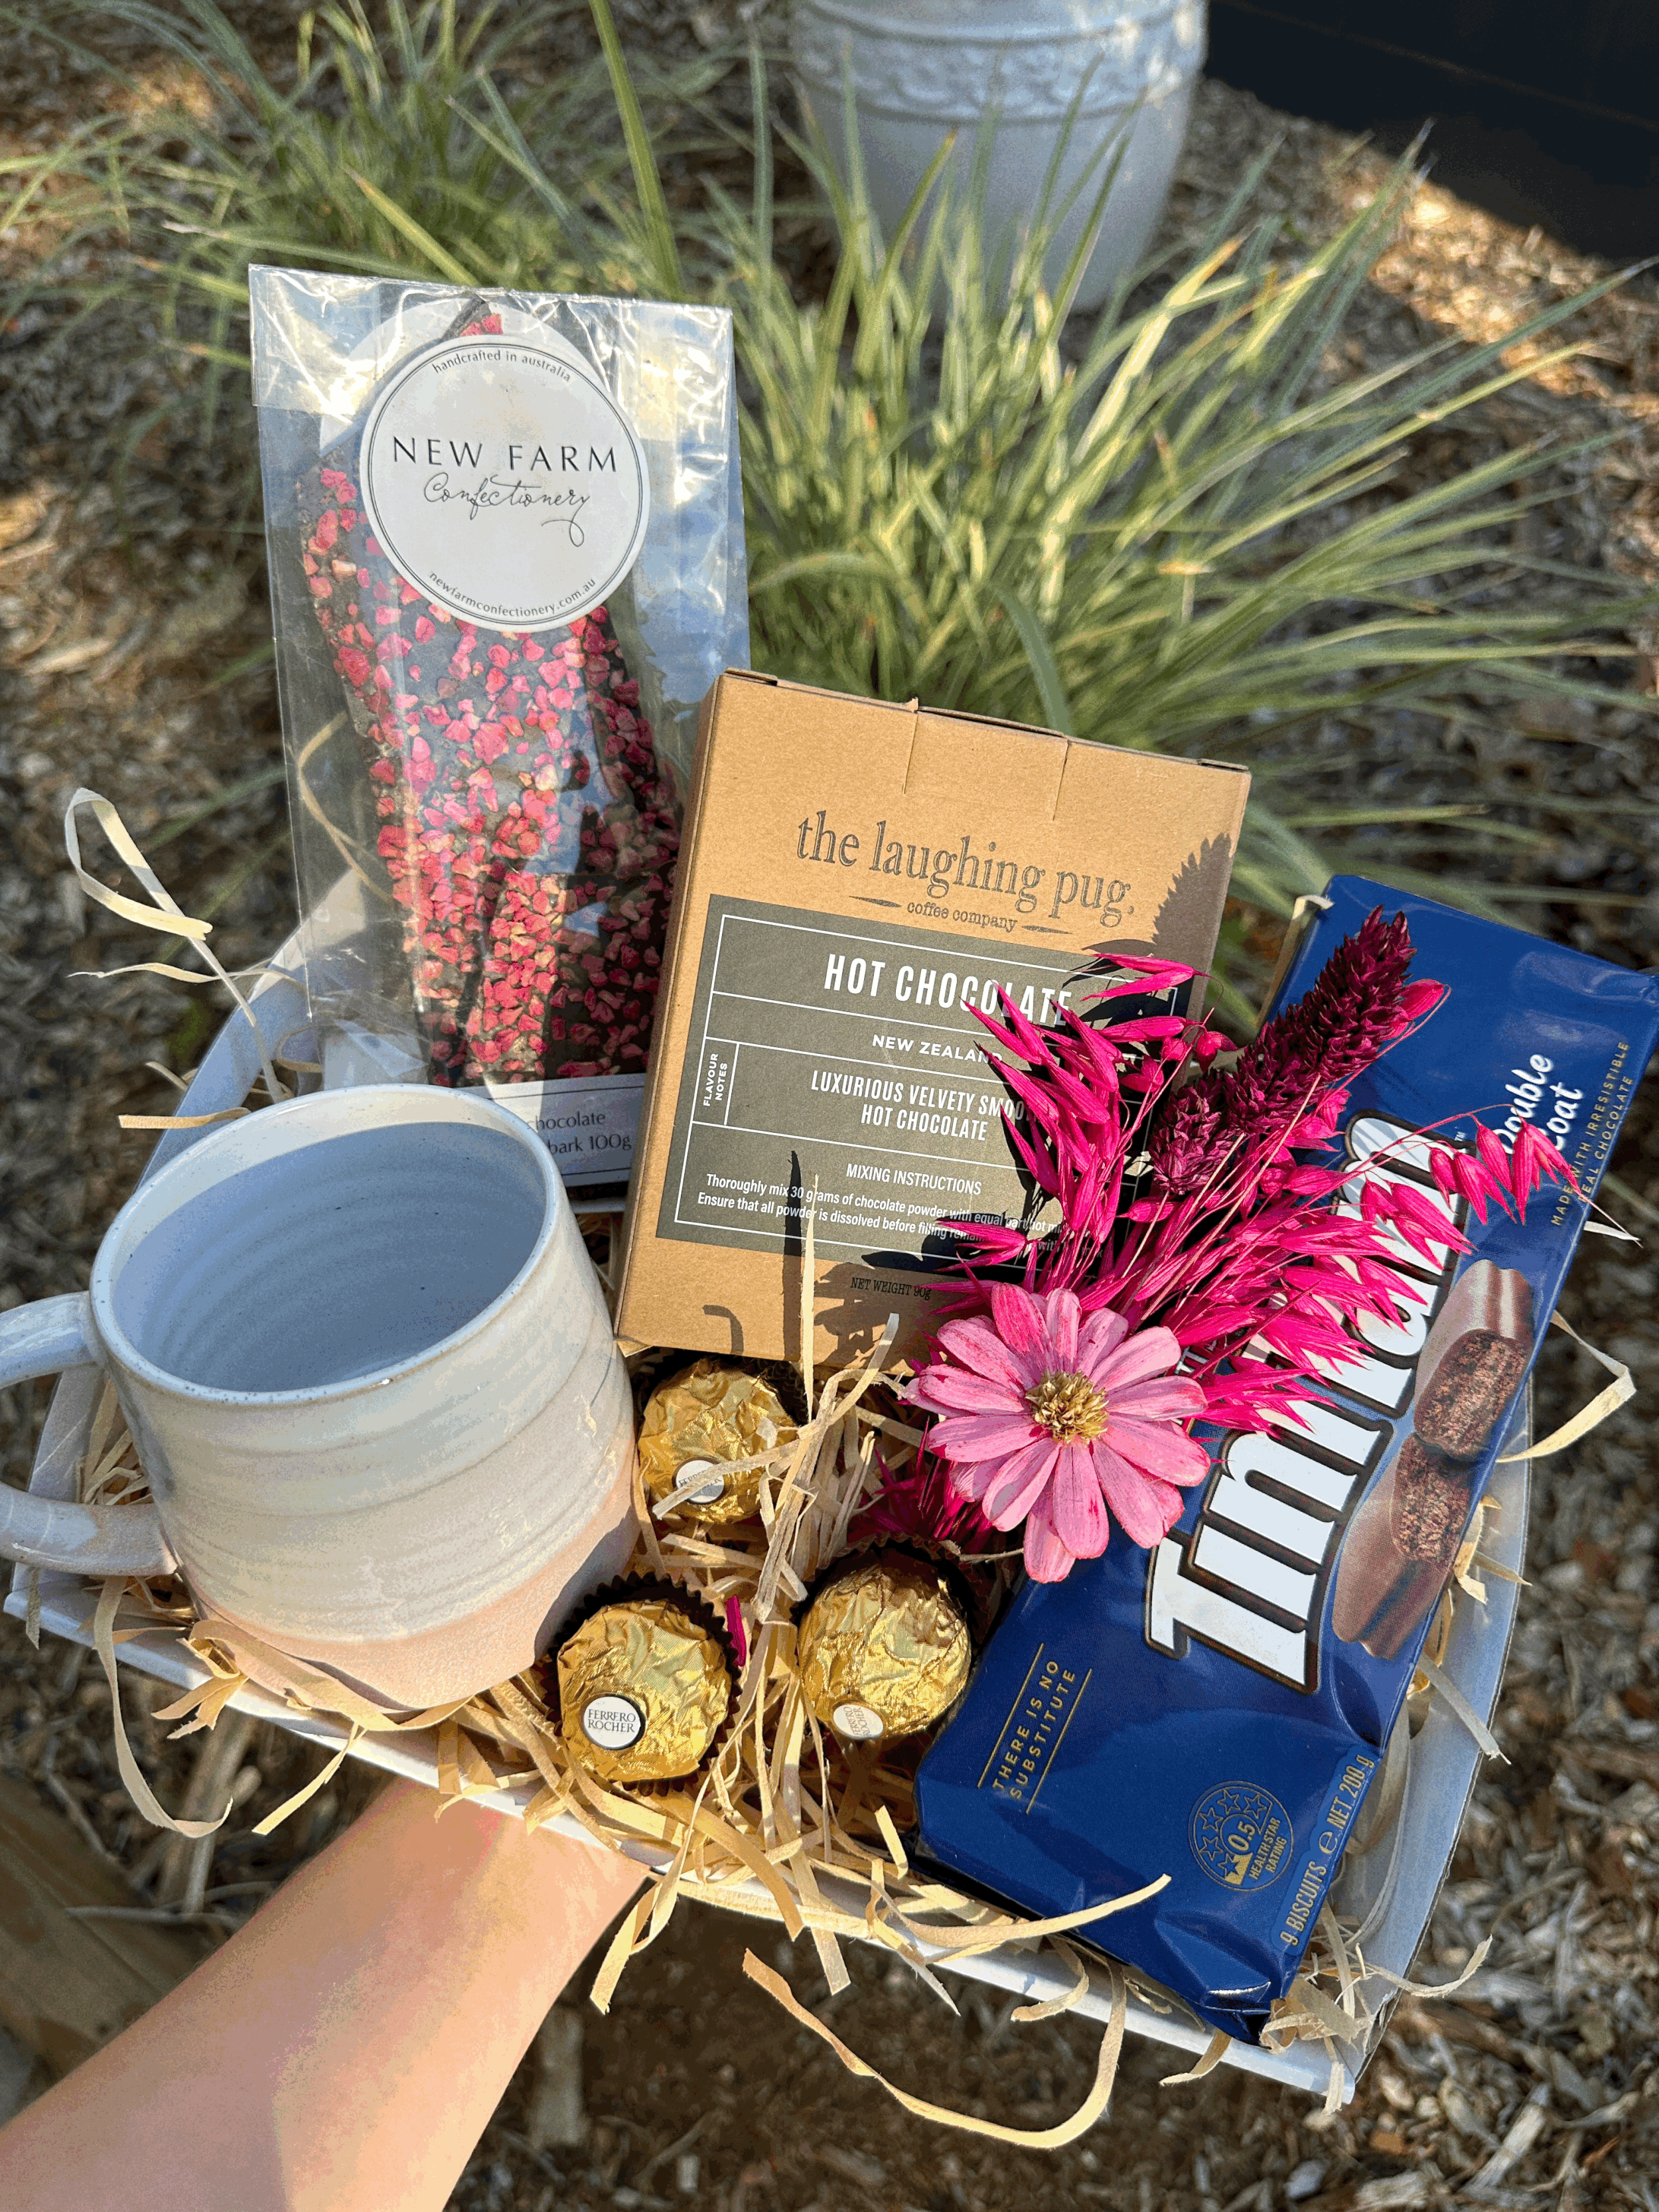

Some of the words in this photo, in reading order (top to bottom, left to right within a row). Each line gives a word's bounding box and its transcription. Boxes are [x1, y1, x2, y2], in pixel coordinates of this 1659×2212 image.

[432, 350, 501, 374] handcrafted
[506, 351, 517, 362] in
[522, 356, 571, 382] australia
[394, 436, 482, 468] NEW
[509, 445, 617, 473] FARM
[424, 472, 591, 547] Confectionery
[429, 571, 596, 617] newfarmconfectionery.com.au
[797, 810, 859, 867] the
[869, 820, 1046, 913] laughing
[906, 901, 949, 919] coffee
[952, 909, 1018, 932] company
[824, 953, 886, 997] HOT
[895, 966, 1072, 1026] CHOCOLATE
[872, 1034, 914, 1052] NEW
[703, 1053, 719, 1107] FLAVOUR
[715, 1063, 728, 1101] NOTES
[811, 1070, 904, 1103] LUXURIOUS
[910, 1084, 975, 1113] VELVETY
[978, 1095, 1037, 1122] SMOO
[861, 1104, 893, 1127] HOT
[897, 1109, 988, 1142] CHOCOLATE
[1551, 1185, 1575, 1226] MADE
[1571, 1142, 1593, 1178] WITH
[1585, 1041, 1630, 1137] IRRESISTIBLE
[1595, 1076, 1633, 1159] CHOCOLATE
[546, 1136, 583, 1155] bark
[590, 1133, 632, 1151] 100g
[846, 1163, 891, 1183] MIXING
[893, 1169, 982, 1195] INSTRUCTIONS
[697, 1191, 735, 1209] Ensure
[737, 1197, 758, 1213] that
[760, 1201, 774, 1214] all
[776, 1205, 817, 1220] powder
[819, 1208, 828, 1221] is
[830, 1210, 880, 1228] dissolved
[883, 1217, 916, 1233] before
[918, 1221, 947, 1240] filling
[707, 1173, 768, 1196] Thoroughly
[769, 1183, 788, 1197] mix
[790, 1185, 804, 1199] 30
[842, 1193, 854, 1205] of
[855, 1195, 906, 1213] chocolate
[907, 1203, 948, 1218] powder
[950, 1208, 972, 1222] with
[974, 1213, 1003, 1226] equal
[850, 1277, 871, 1291] NET
[873, 1280, 912, 1296] WEIGHT
[913, 1286, 932, 1301] 90g
[1145, 1398, 1392, 1694] Tim
[588, 1708, 636, 1722] FERRERO
[588, 1719, 635, 1733] ROCHER
[992, 1726, 1030, 1790] THERE
[1026, 1697, 1043, 1719] IS
[1039, 1660, 1058, 1691] NO
[1009, 1669, 1076, 1800] SUBSTITUTE
[1356, 1753, 1376, 1769] g
[1339, 1764, 1366, 1799] 200
[1326, 1796, 1353, 1830] NET
[1228, 1820, 1256, 1852] 0.5
[1248, 1842, 1271, 1880] HEALTH
[1263, 1817, 1281, 1844] STAR
[1265, 1836, 1287, 1874] RATING
[1285, 1860, 1327, 1933] BISCUITS
[1279, 1930, 1299, 1947] 9
